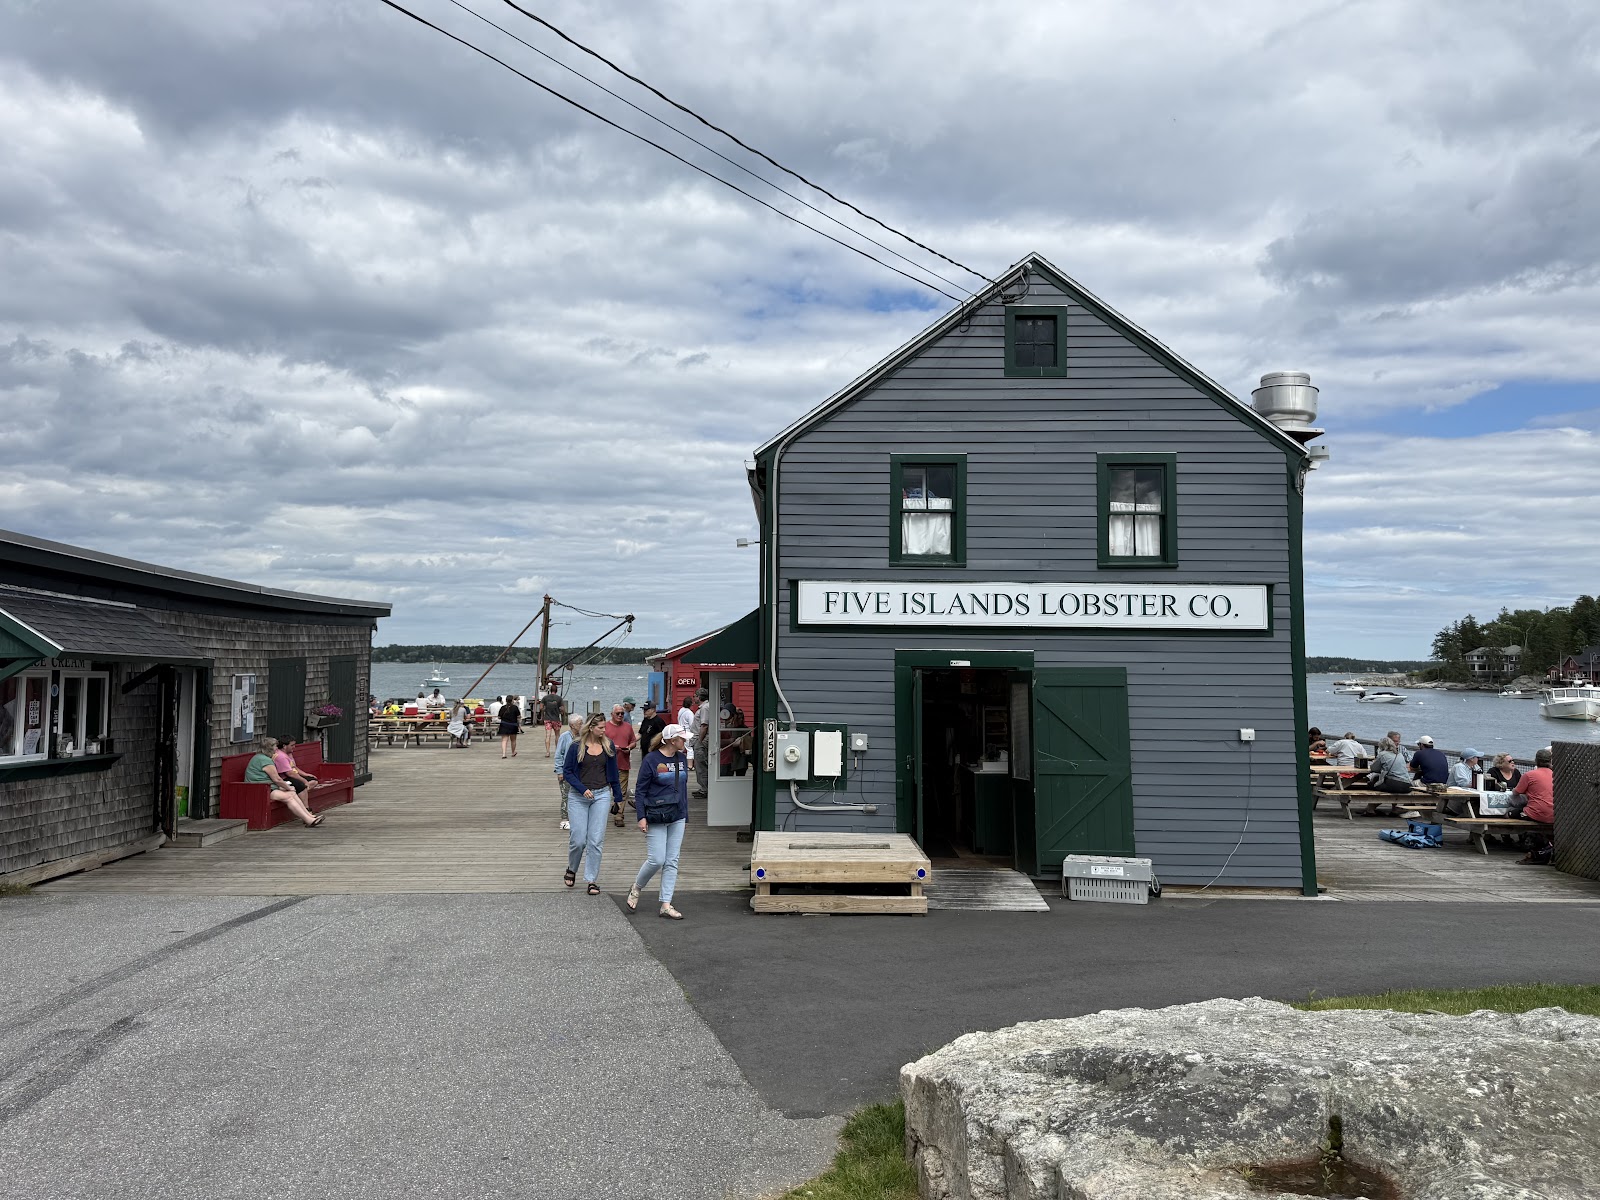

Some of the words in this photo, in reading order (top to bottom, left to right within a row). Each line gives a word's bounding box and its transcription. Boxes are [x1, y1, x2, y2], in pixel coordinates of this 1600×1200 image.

[822, 591, 892, 615] FIVE
[899, 592, 1030, 616] ISLANDS
[1038, 592, 1181, 618] LOBSTER
[1188, 594, 1239, 619] CO.
[51, 657, 85, 668] CREAM
[767, 722, 775, 768] 04546
